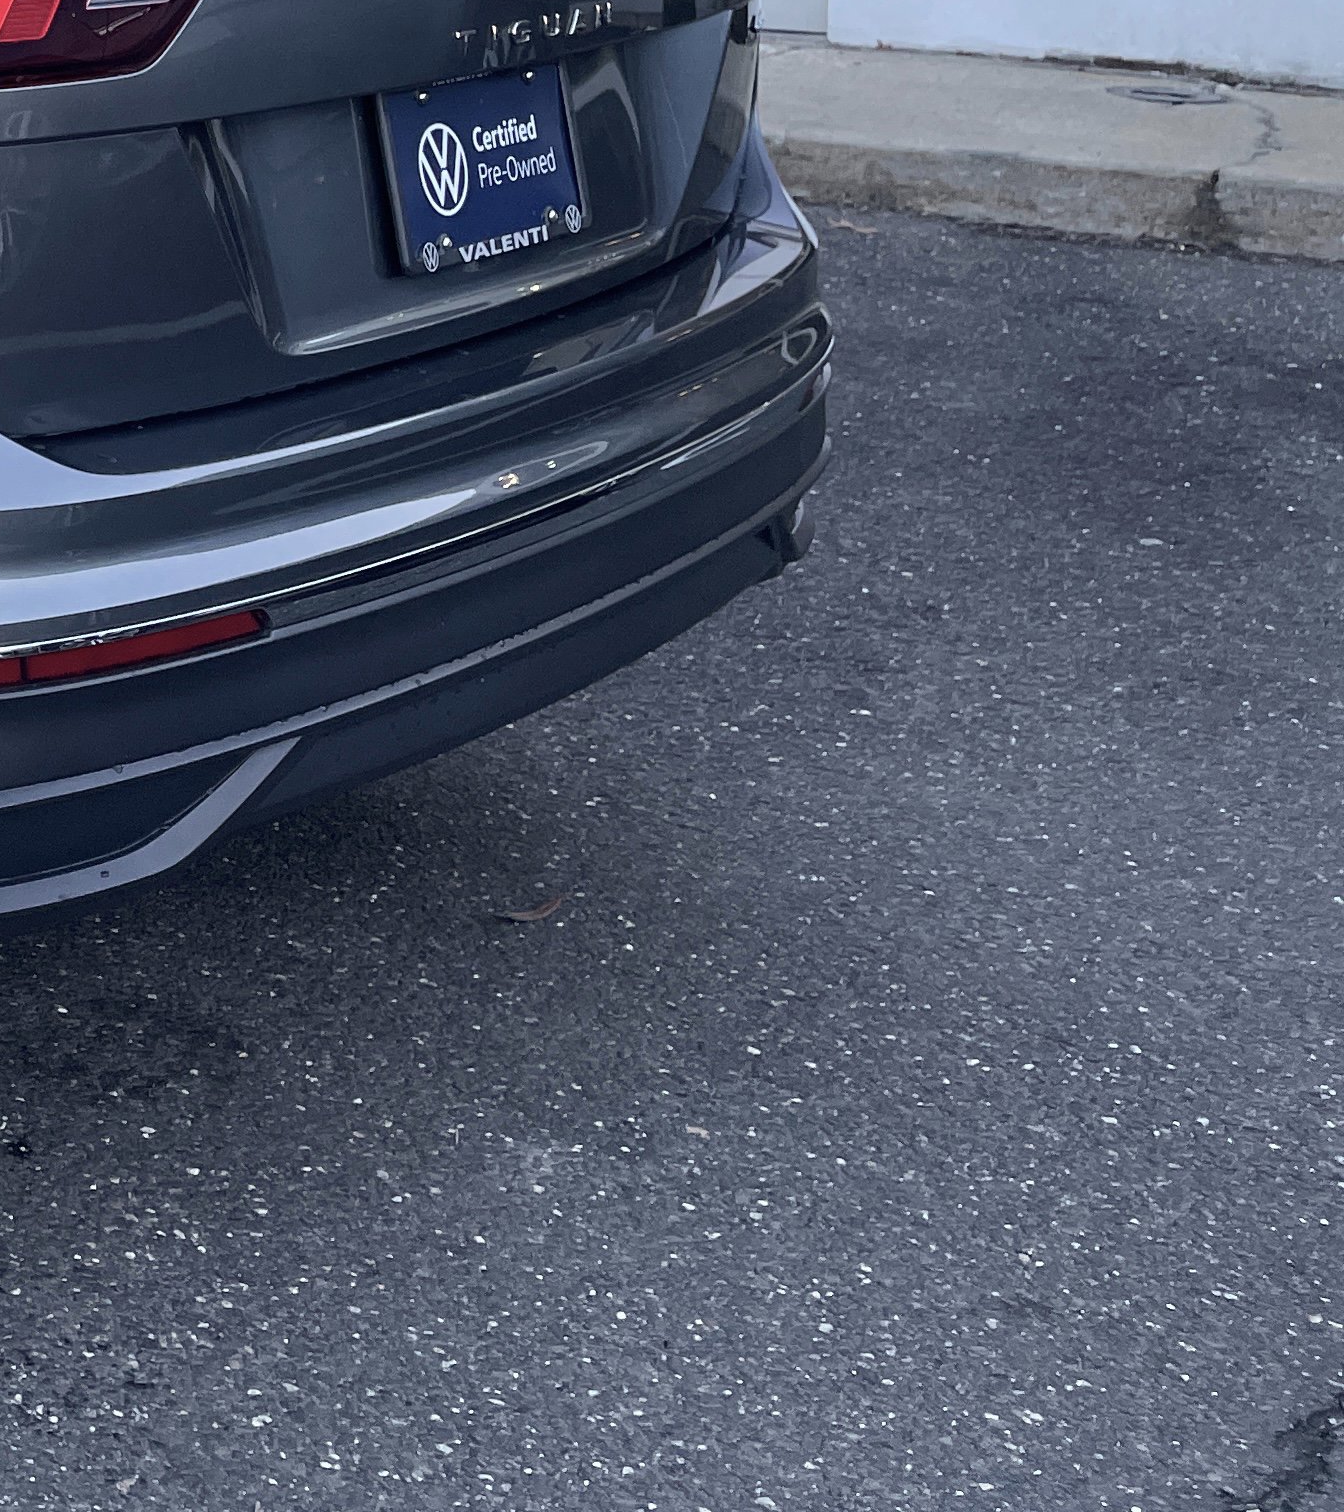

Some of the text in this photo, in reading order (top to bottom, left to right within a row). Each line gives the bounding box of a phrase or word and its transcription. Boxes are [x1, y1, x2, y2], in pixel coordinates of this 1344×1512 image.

[452, 0, 614, 56] TIGUAN
[472, 114, 538, 154] Certified
[478, 146, 557, 190] Pre-Owned
[458, 224, 550, 264] VALENTI
